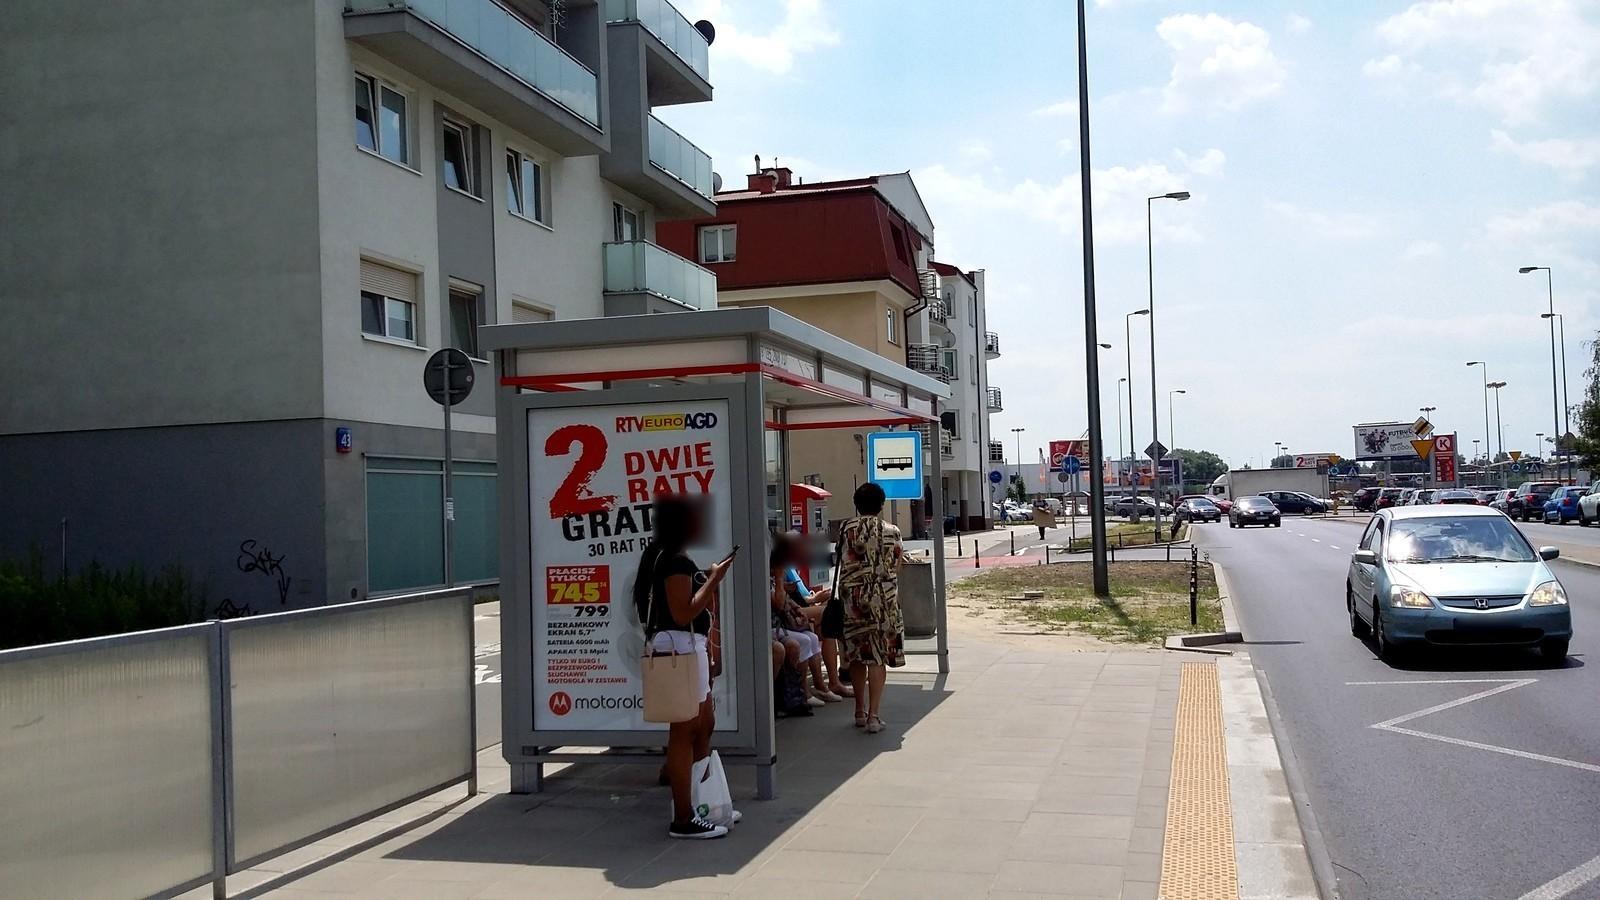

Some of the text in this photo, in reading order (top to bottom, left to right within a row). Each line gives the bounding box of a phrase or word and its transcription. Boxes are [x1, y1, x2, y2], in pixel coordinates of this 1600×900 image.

[616, 413, 718, 433] RTV EURO AGD
[624, 442, 713, 476] DWIE
[544, 424, 620, 520] 2
[628, 469, 715, 503] RATY
[588, 542, 605, 557] 30
[610, 539, 634, 554] RAT
[550, 582, 600, 603] 745
[574, 605, 609, 617] 799
[547, 621, 610, 629] BEZRAMKOWY
